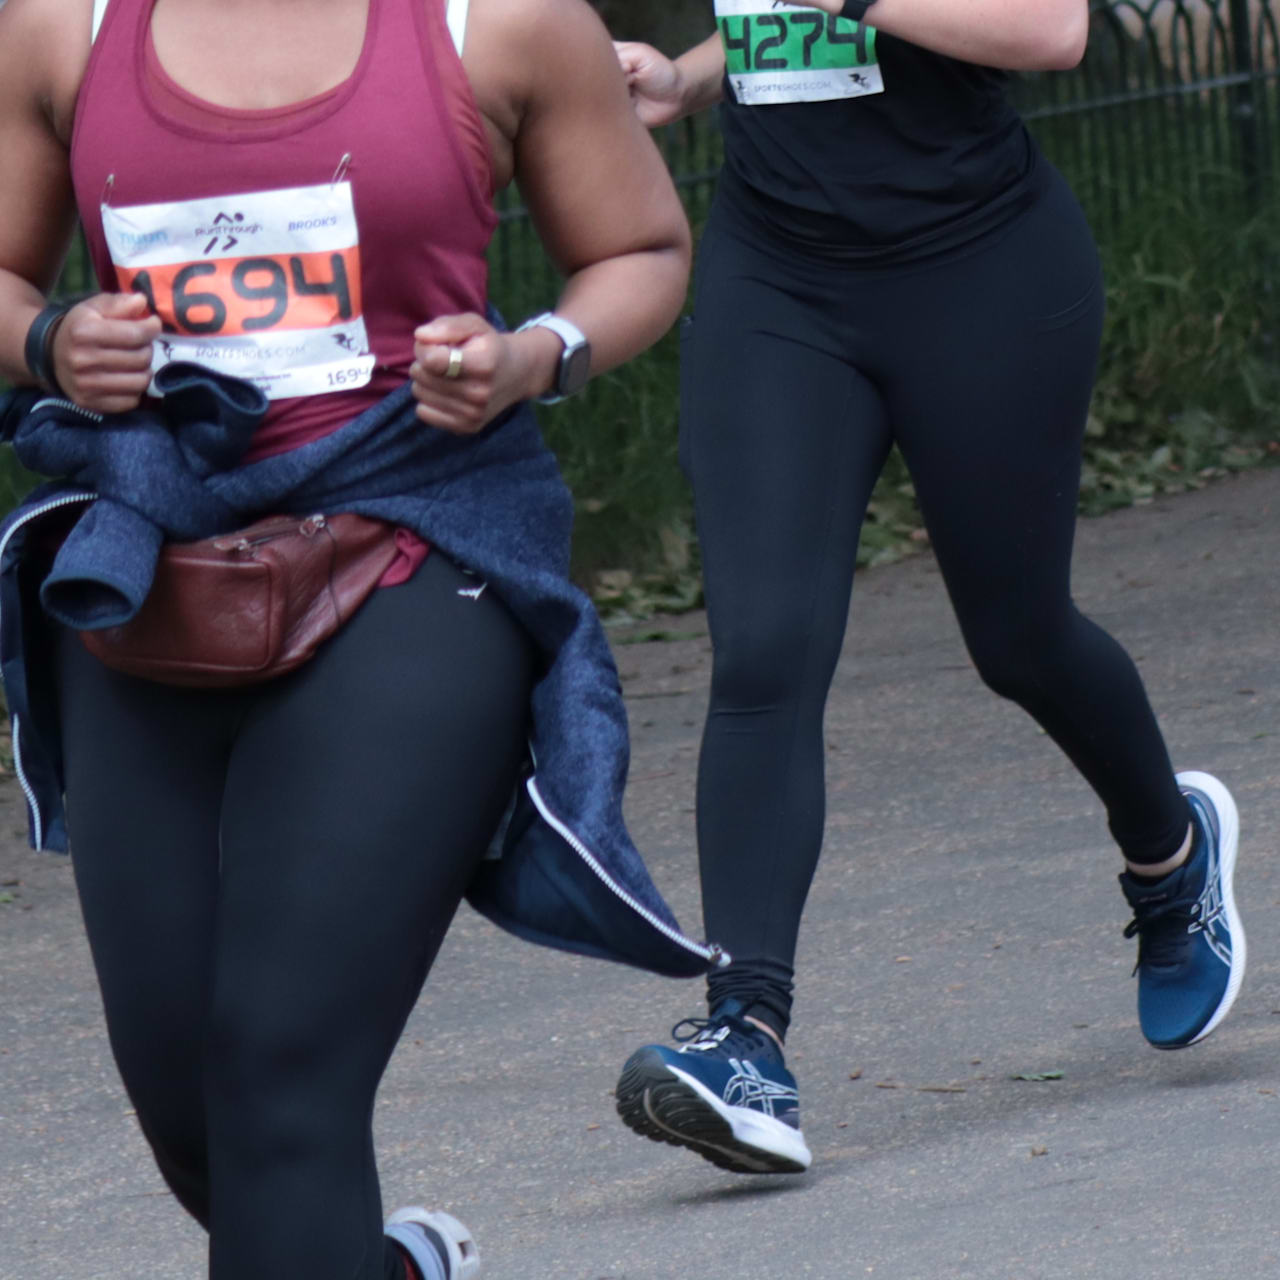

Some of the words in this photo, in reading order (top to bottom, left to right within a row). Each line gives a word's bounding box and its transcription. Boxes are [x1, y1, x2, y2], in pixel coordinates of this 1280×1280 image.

[722, 12, 868, 70] 4274
[287, 216, 338, 233] BROOKS
[130, 252, 353, 335] 1694
